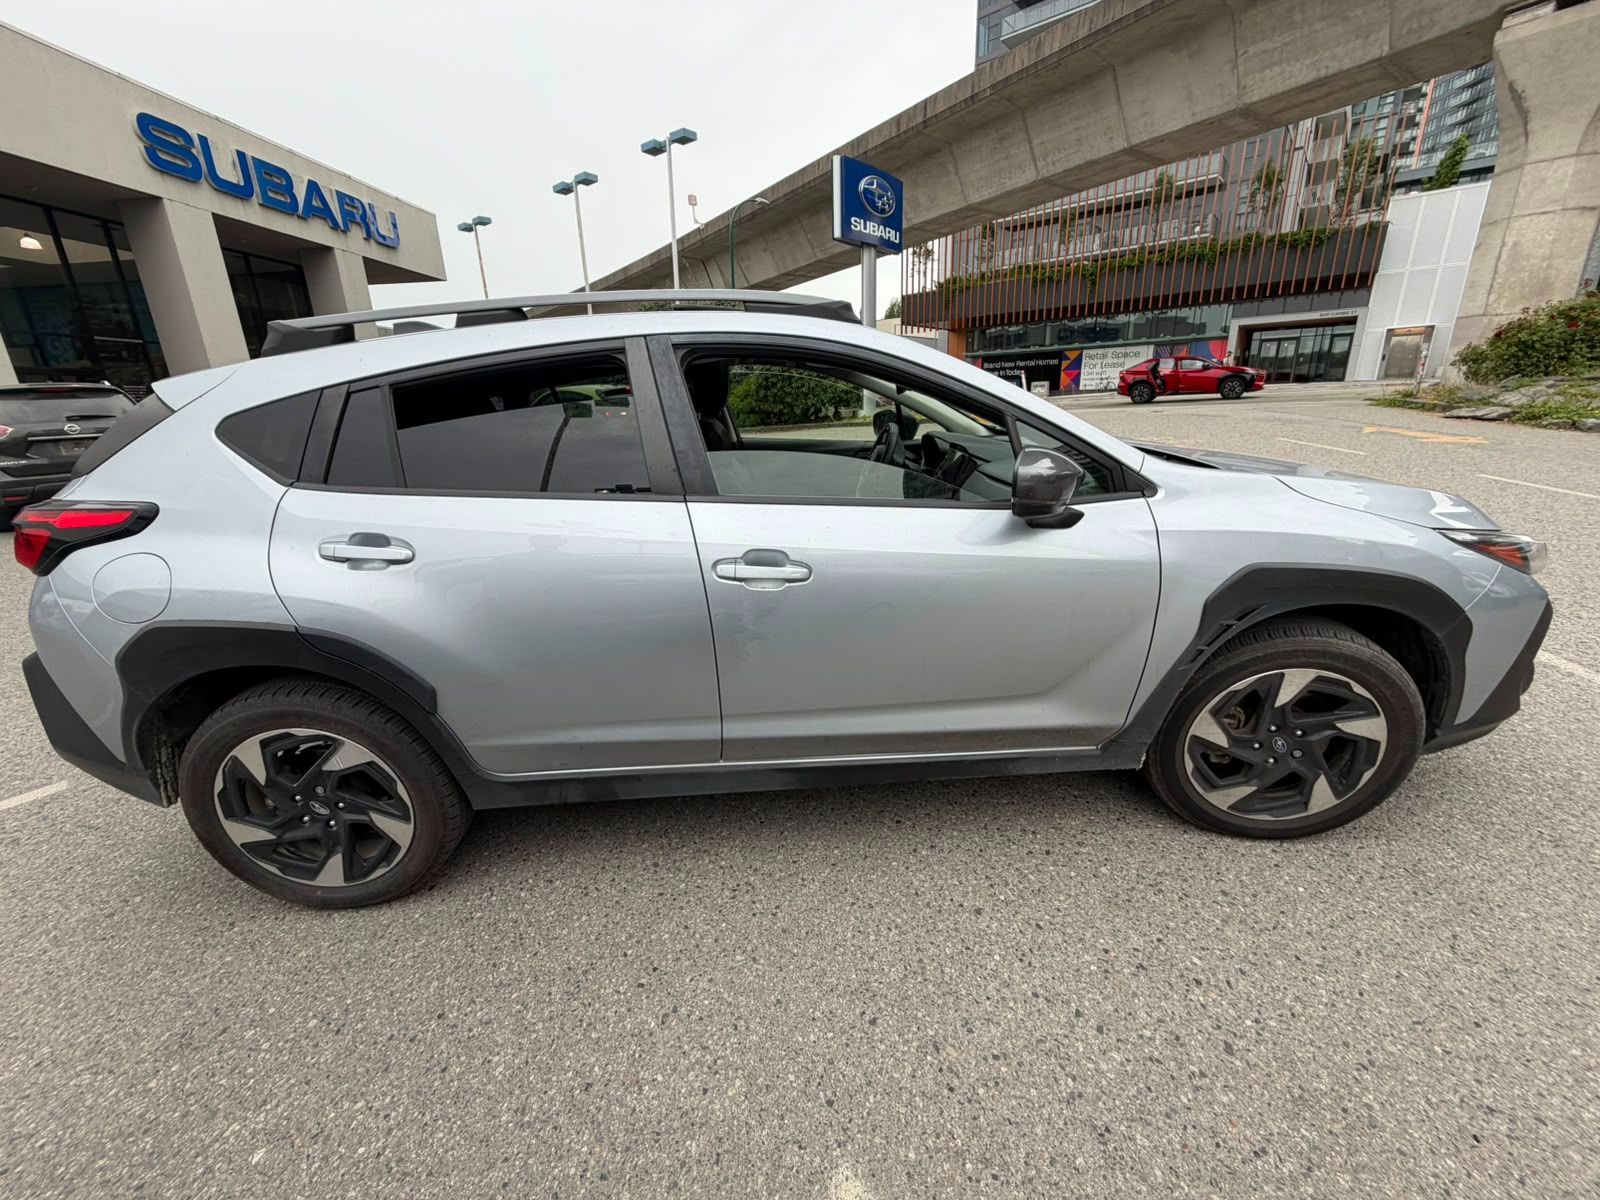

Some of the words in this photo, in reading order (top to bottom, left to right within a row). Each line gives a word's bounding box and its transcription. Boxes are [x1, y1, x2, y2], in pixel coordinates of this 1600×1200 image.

[132, 112, 400, 249] SUBARU
[850, 216, 900, 243] SUBARU
[1085, 352, 1108, 360] Retail
[1111, 350, 1140, 360] Space
[1084, 361, 1098, 370] For
[1101, 361, 1125, 369] Lease
